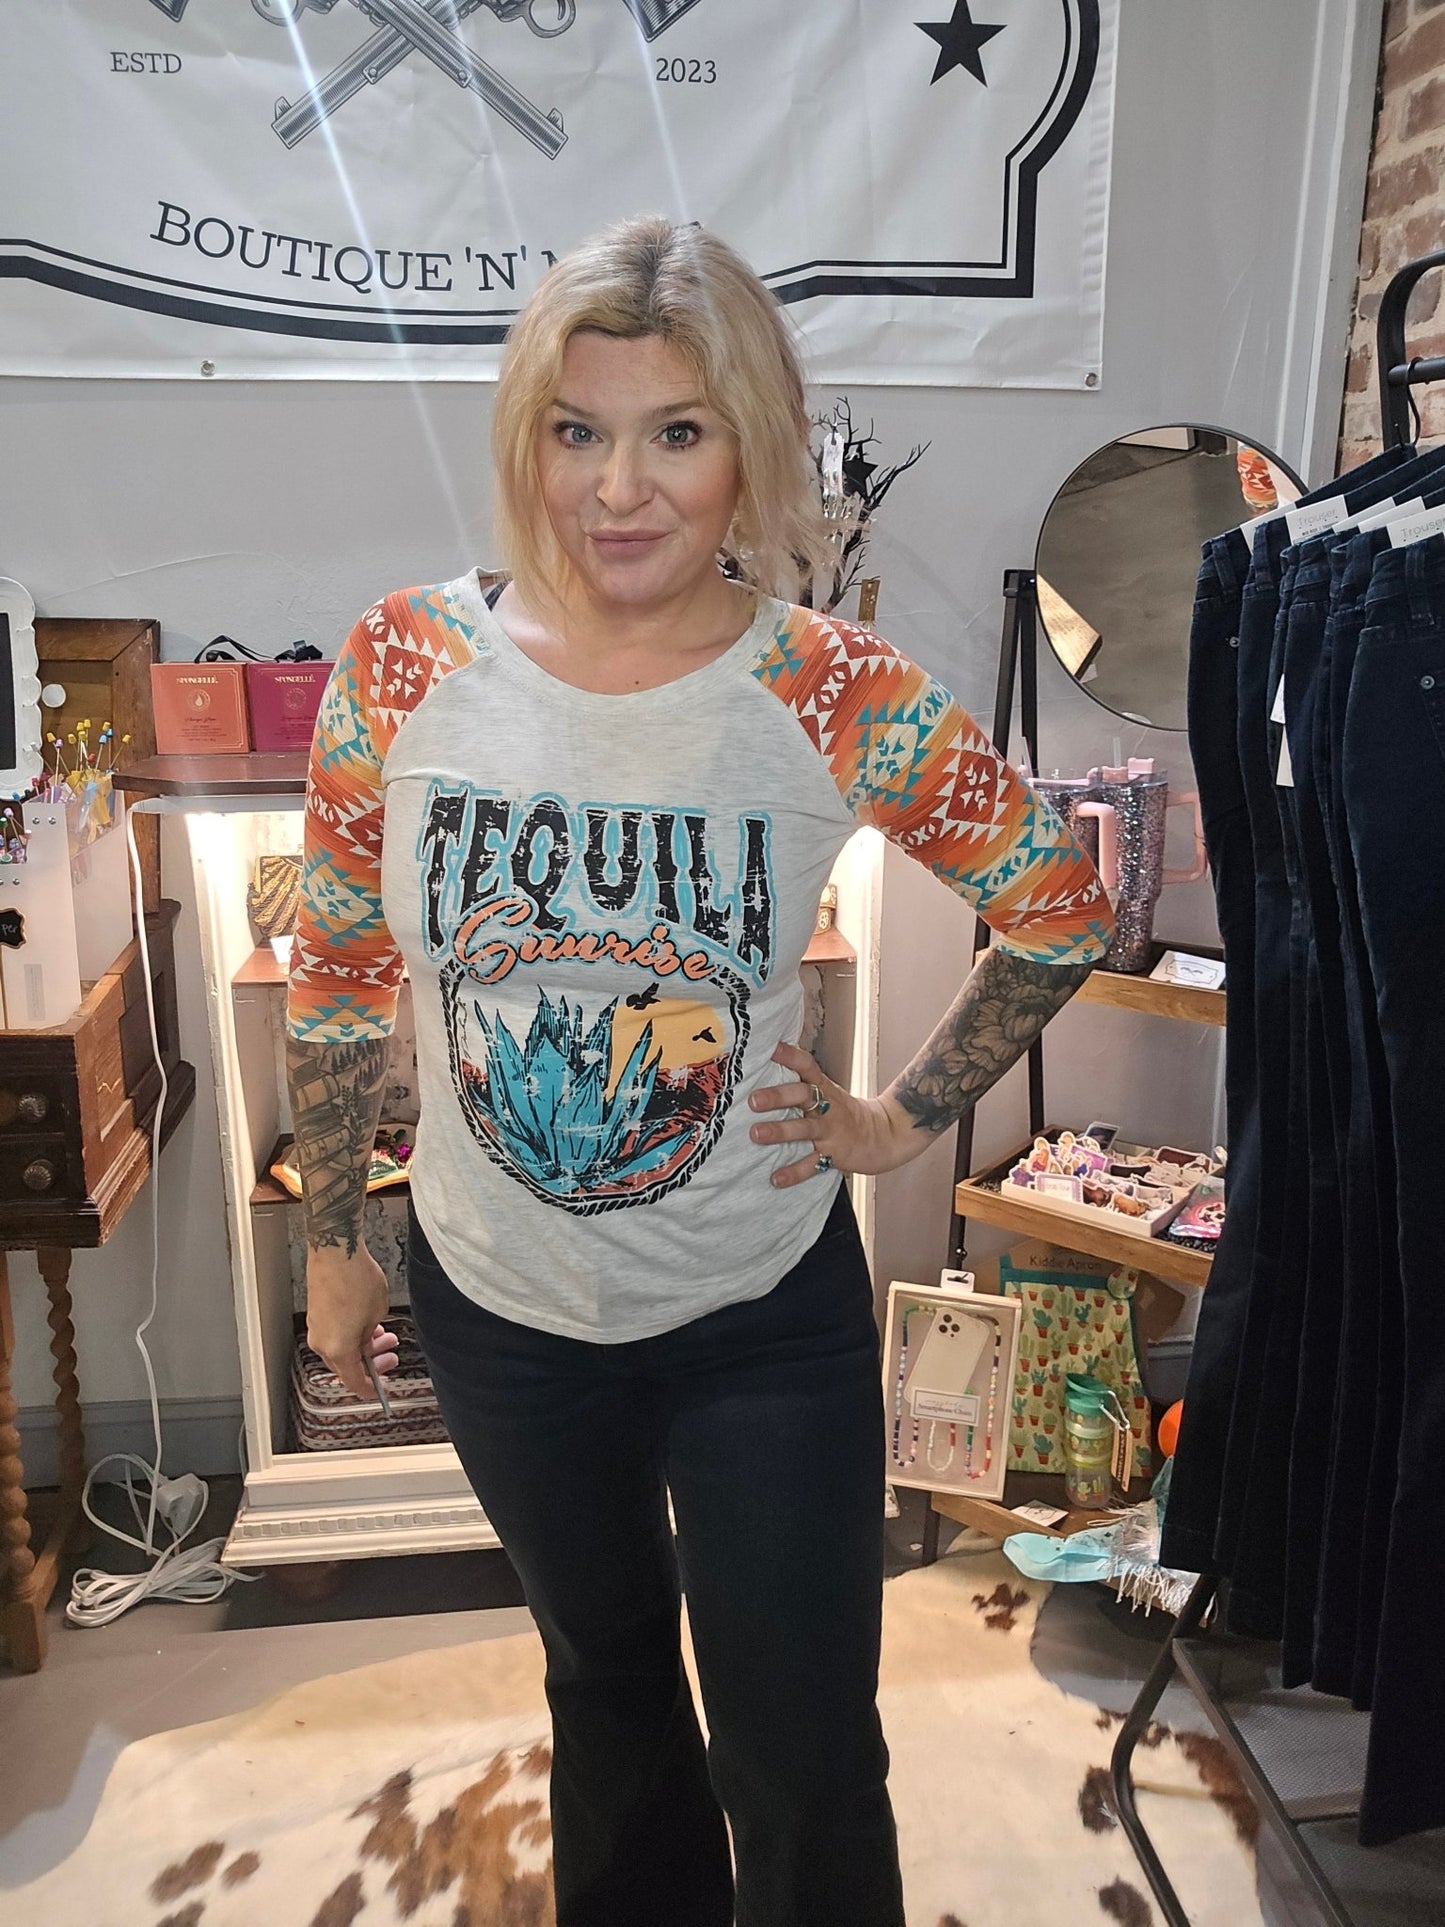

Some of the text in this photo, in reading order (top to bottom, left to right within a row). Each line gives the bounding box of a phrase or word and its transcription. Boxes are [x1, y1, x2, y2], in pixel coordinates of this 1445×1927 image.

[109, 51, 182, 74] ESTD
[655, 57, 717, 84] 2023
[149, 200, 453, 294] BOUTIQUE
[453, 897, 719, 986] Sunrise
